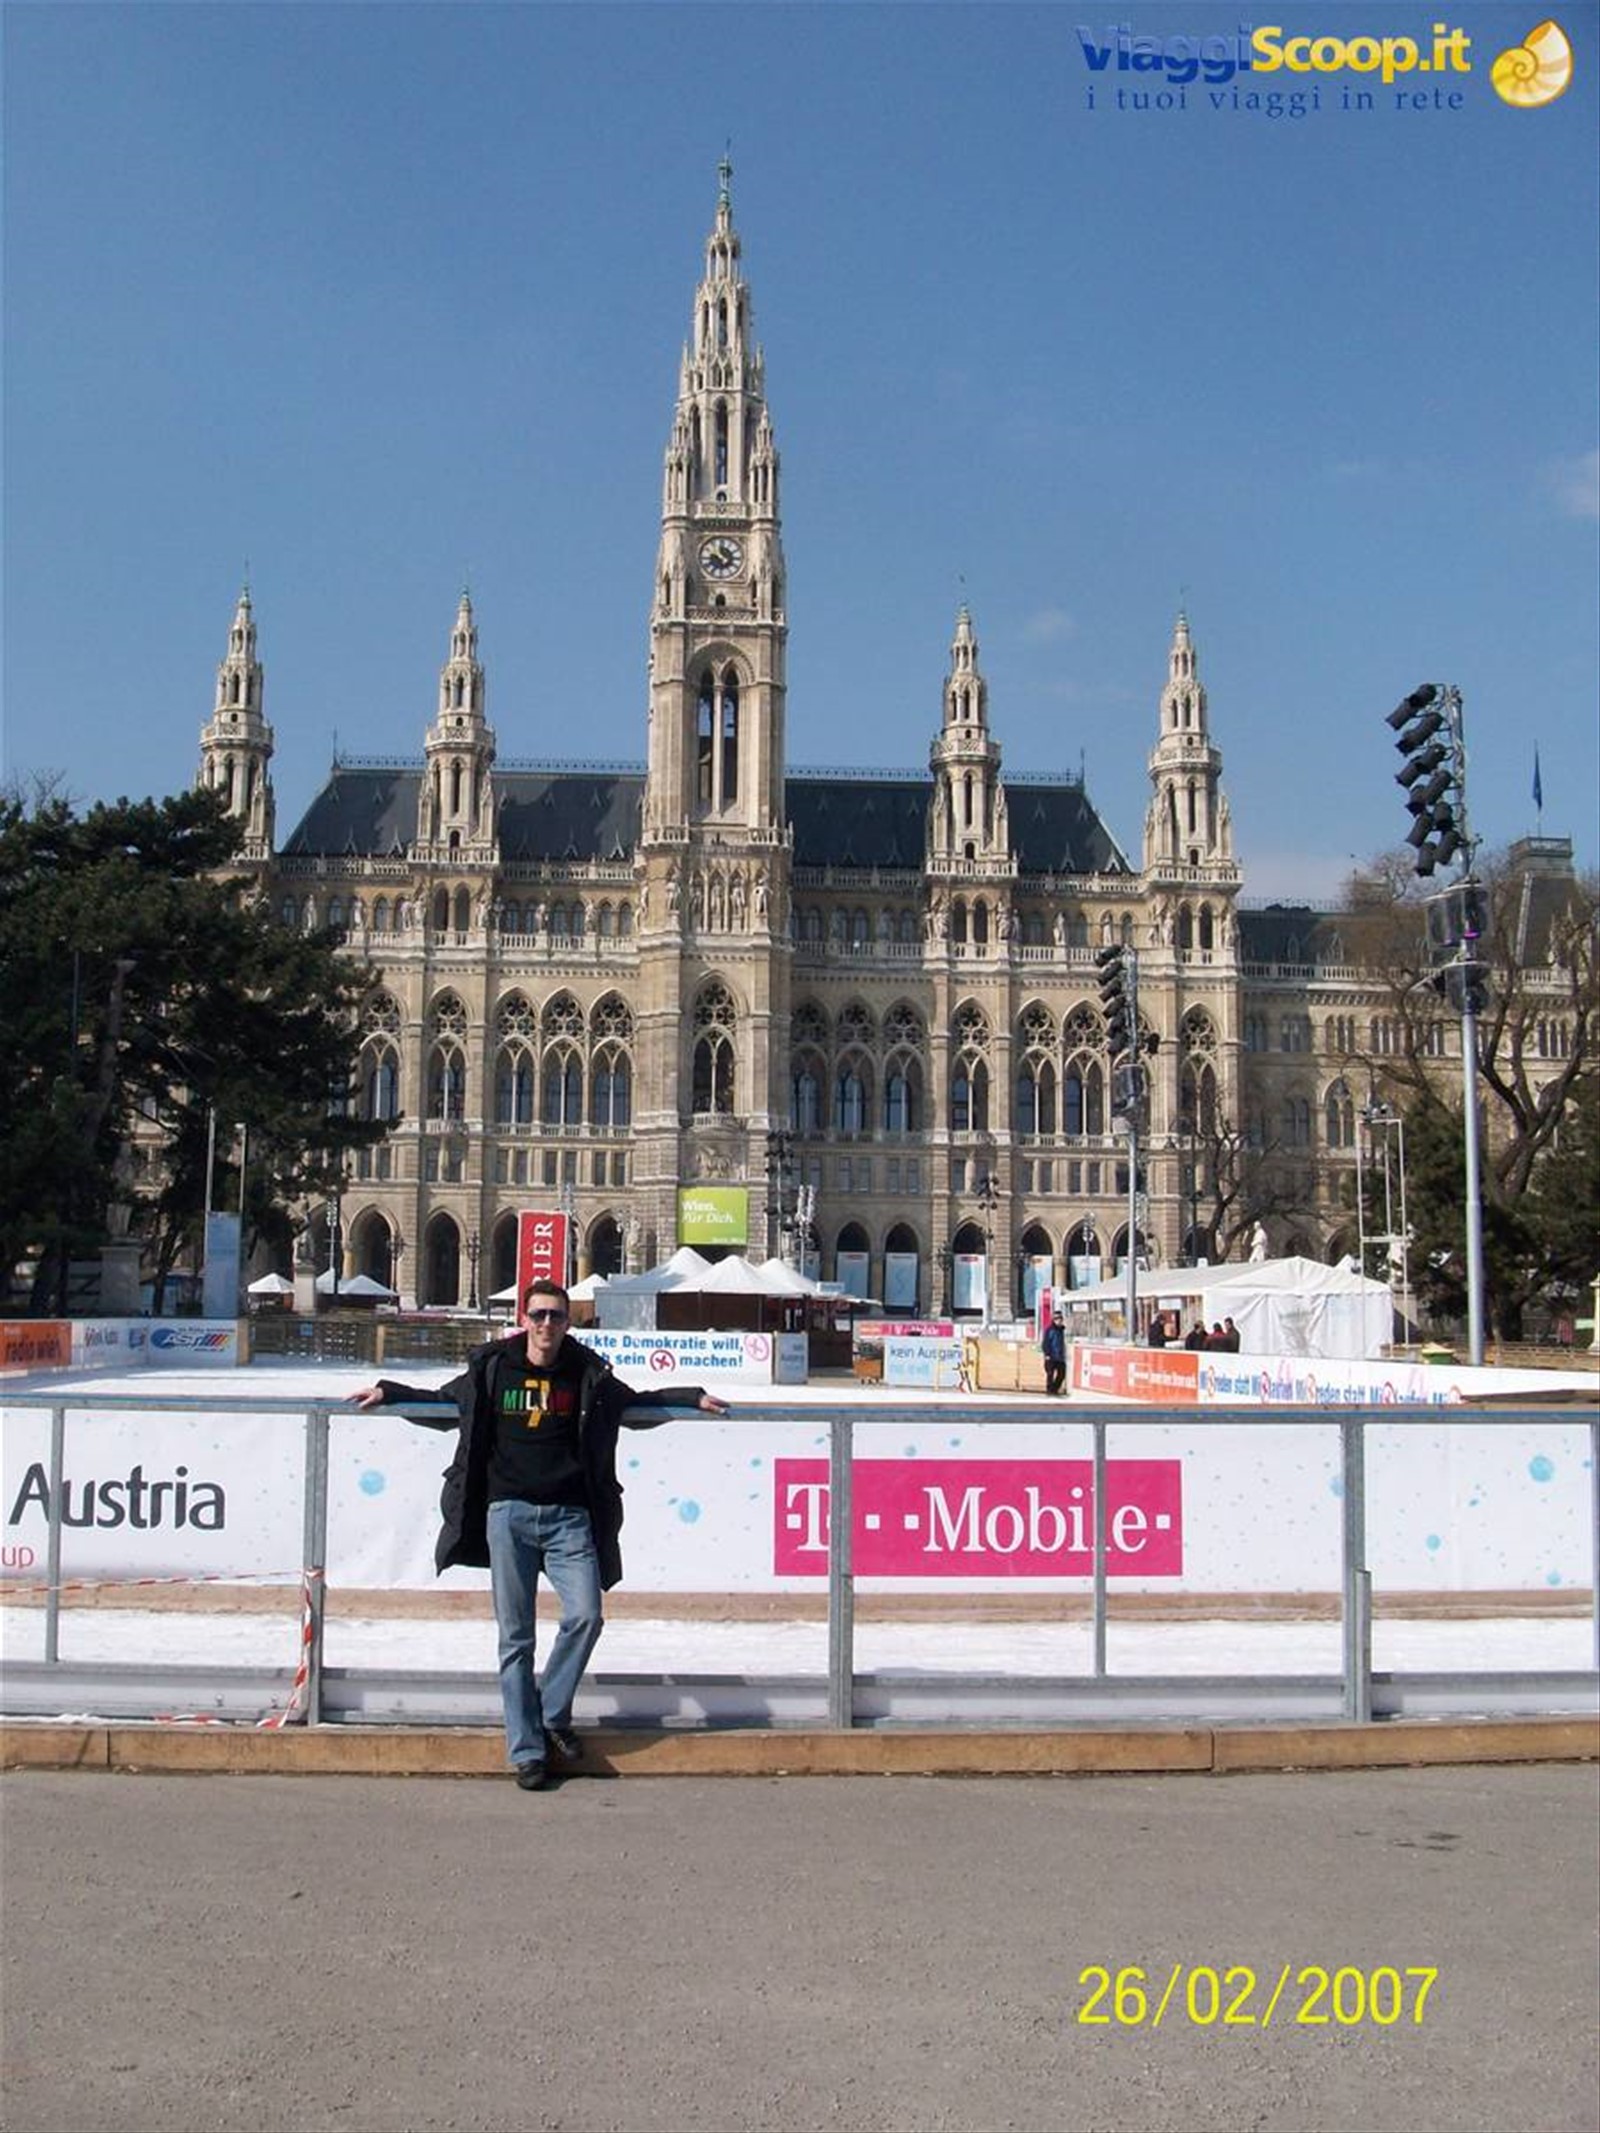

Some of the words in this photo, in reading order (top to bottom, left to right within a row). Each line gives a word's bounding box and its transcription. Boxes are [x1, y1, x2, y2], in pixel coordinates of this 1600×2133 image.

[622, 1334, 706, 1350] Demokratie
[711, 1335, 743, 1352] will,
[615, 1354, 646, 1365] sein
[679, 1354, 743, 1367] machen!
[8, 1462, 226, 1531] Austria
